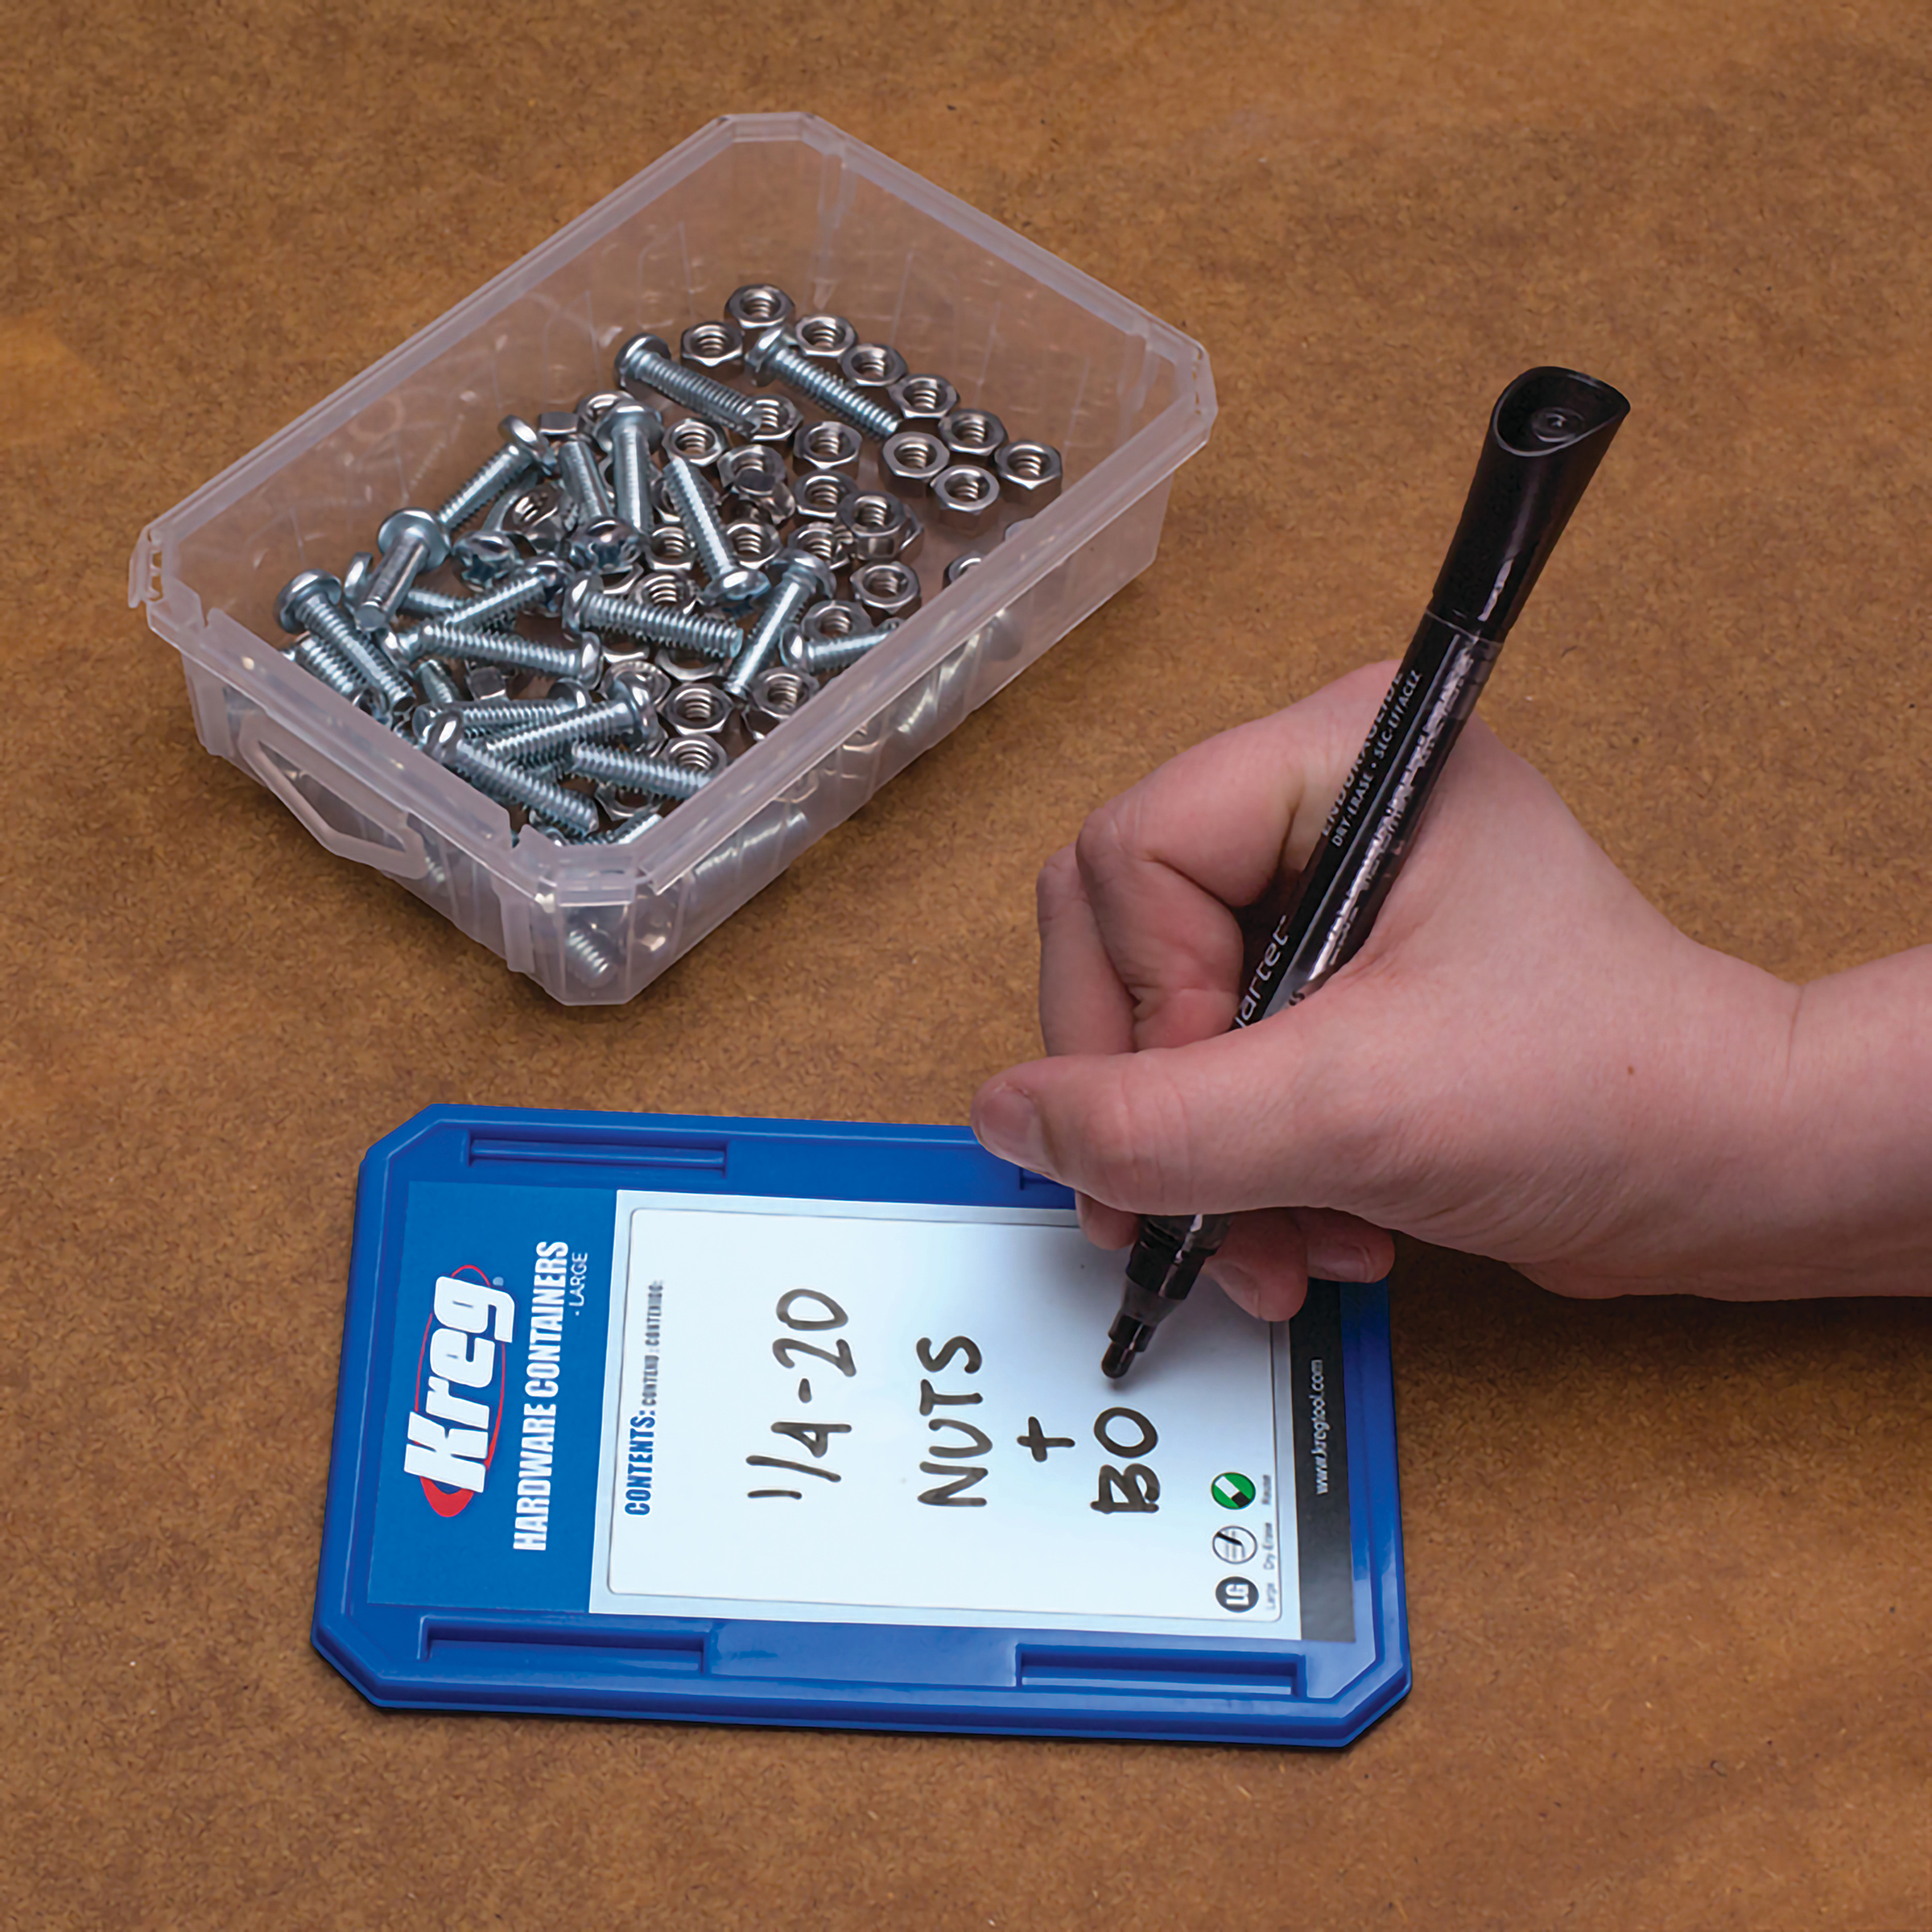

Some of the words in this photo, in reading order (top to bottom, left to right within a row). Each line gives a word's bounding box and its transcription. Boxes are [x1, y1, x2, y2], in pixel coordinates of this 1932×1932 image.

[524, 1241, 569, 1398] CONTAINERS
[568, 1252, 588, 1307] LARGE
[403, 1275, 516, 1494] Kreg
[745, 1288, 857, 1501] 1/4-20
[916, 1335, 993, 1507] NUTS
[1016, 1415, 1076, 1463] +
[1309, 1359, 1331, 1496] www.kregtool.com
[513, 1403, 557, 1551] HARDWARE
[624, 1410, 656, 1516] CONTENTS:
[1089, 1406, 1161, 1514] BO
[1224, 1583, 1250, 1606] LG
